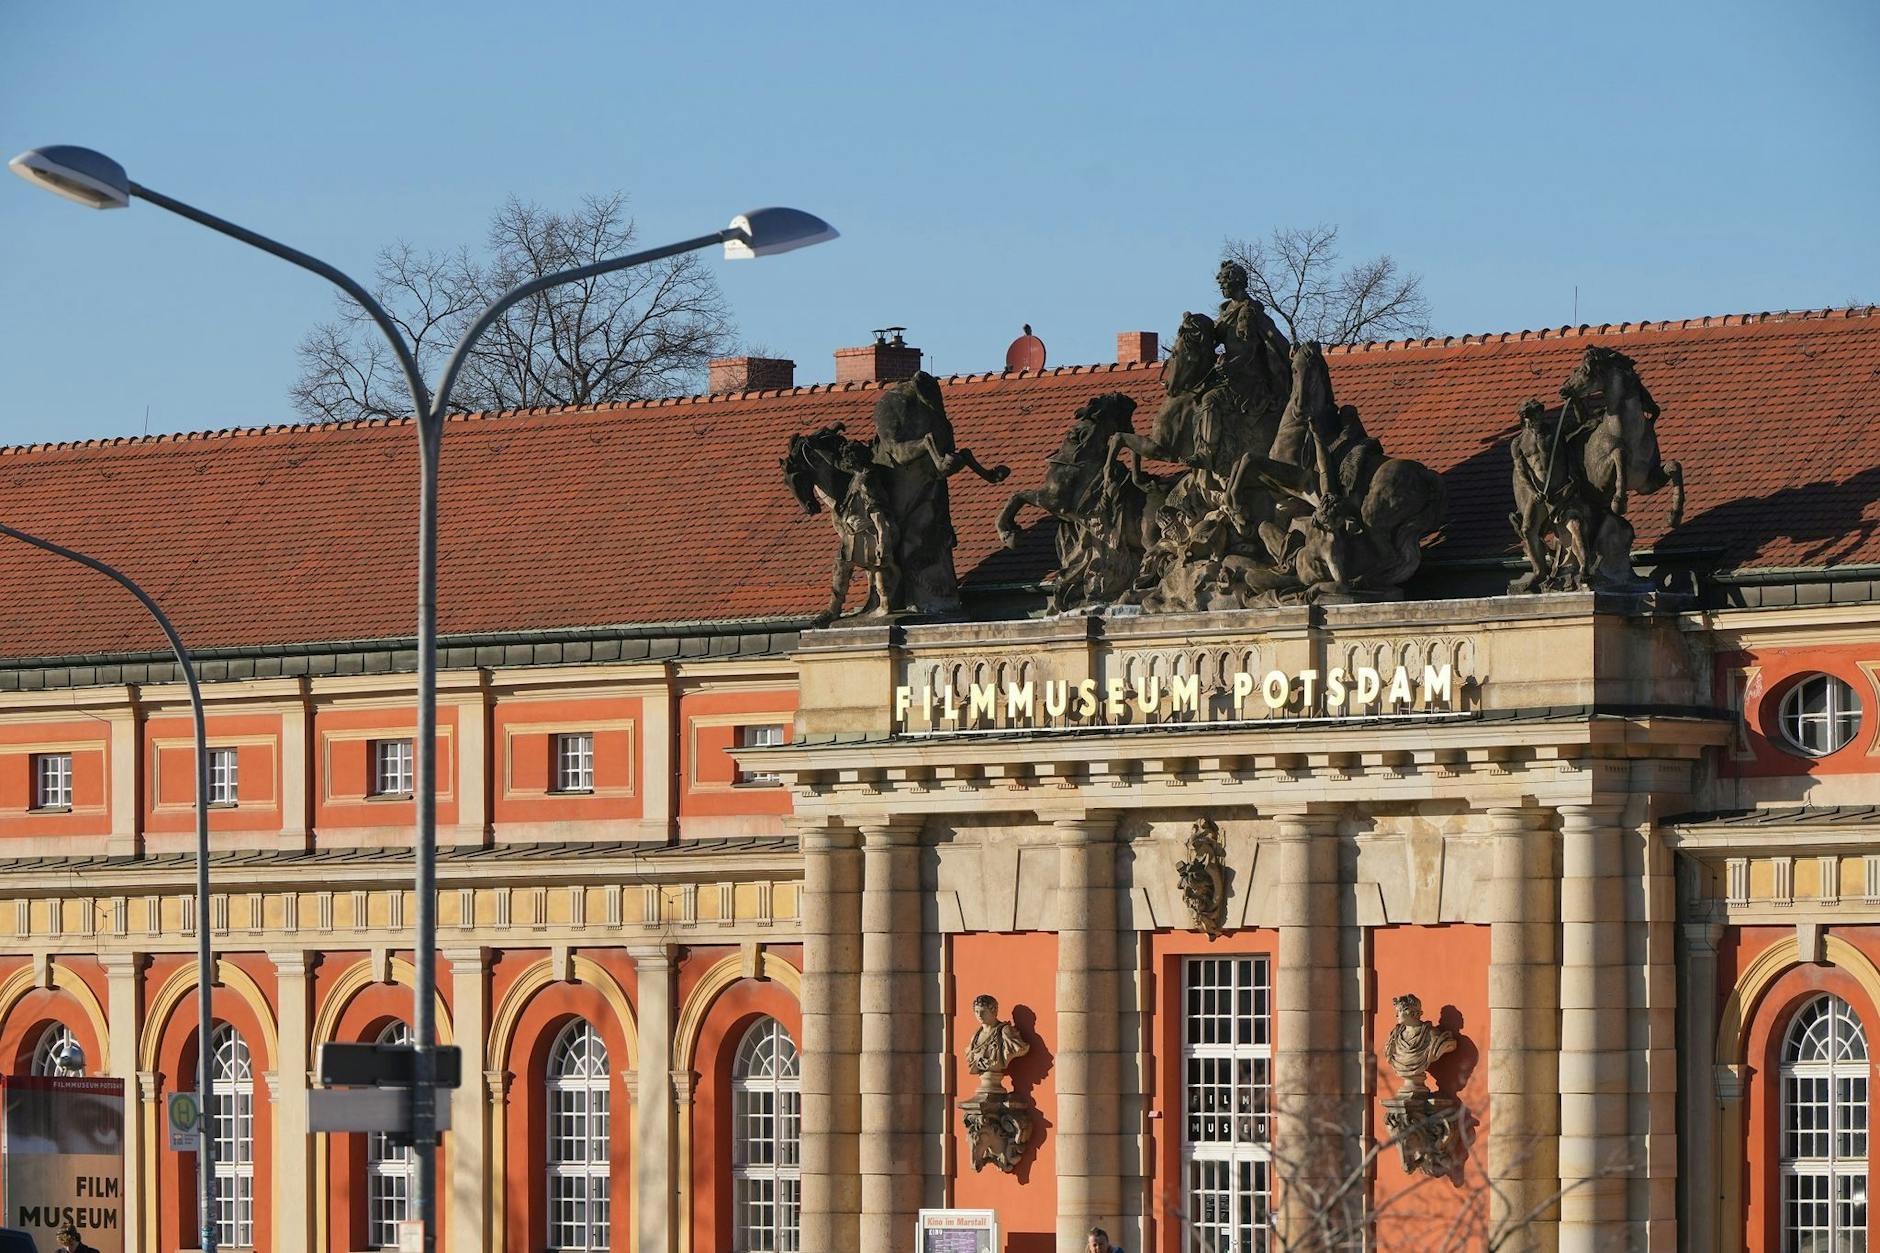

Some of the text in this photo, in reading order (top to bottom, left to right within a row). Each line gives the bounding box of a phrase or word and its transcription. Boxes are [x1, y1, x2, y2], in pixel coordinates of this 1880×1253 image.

[896, 664, 1452, 721] FILMMUSEUM POTSDAM
[1192, 1122, 1265, 1134] MUSEU
[76, 1176, 118, 1198] FILM
[19, 1206, 117, 1229] MUSEUM
[927, 1217, 943, 1226] Kino
